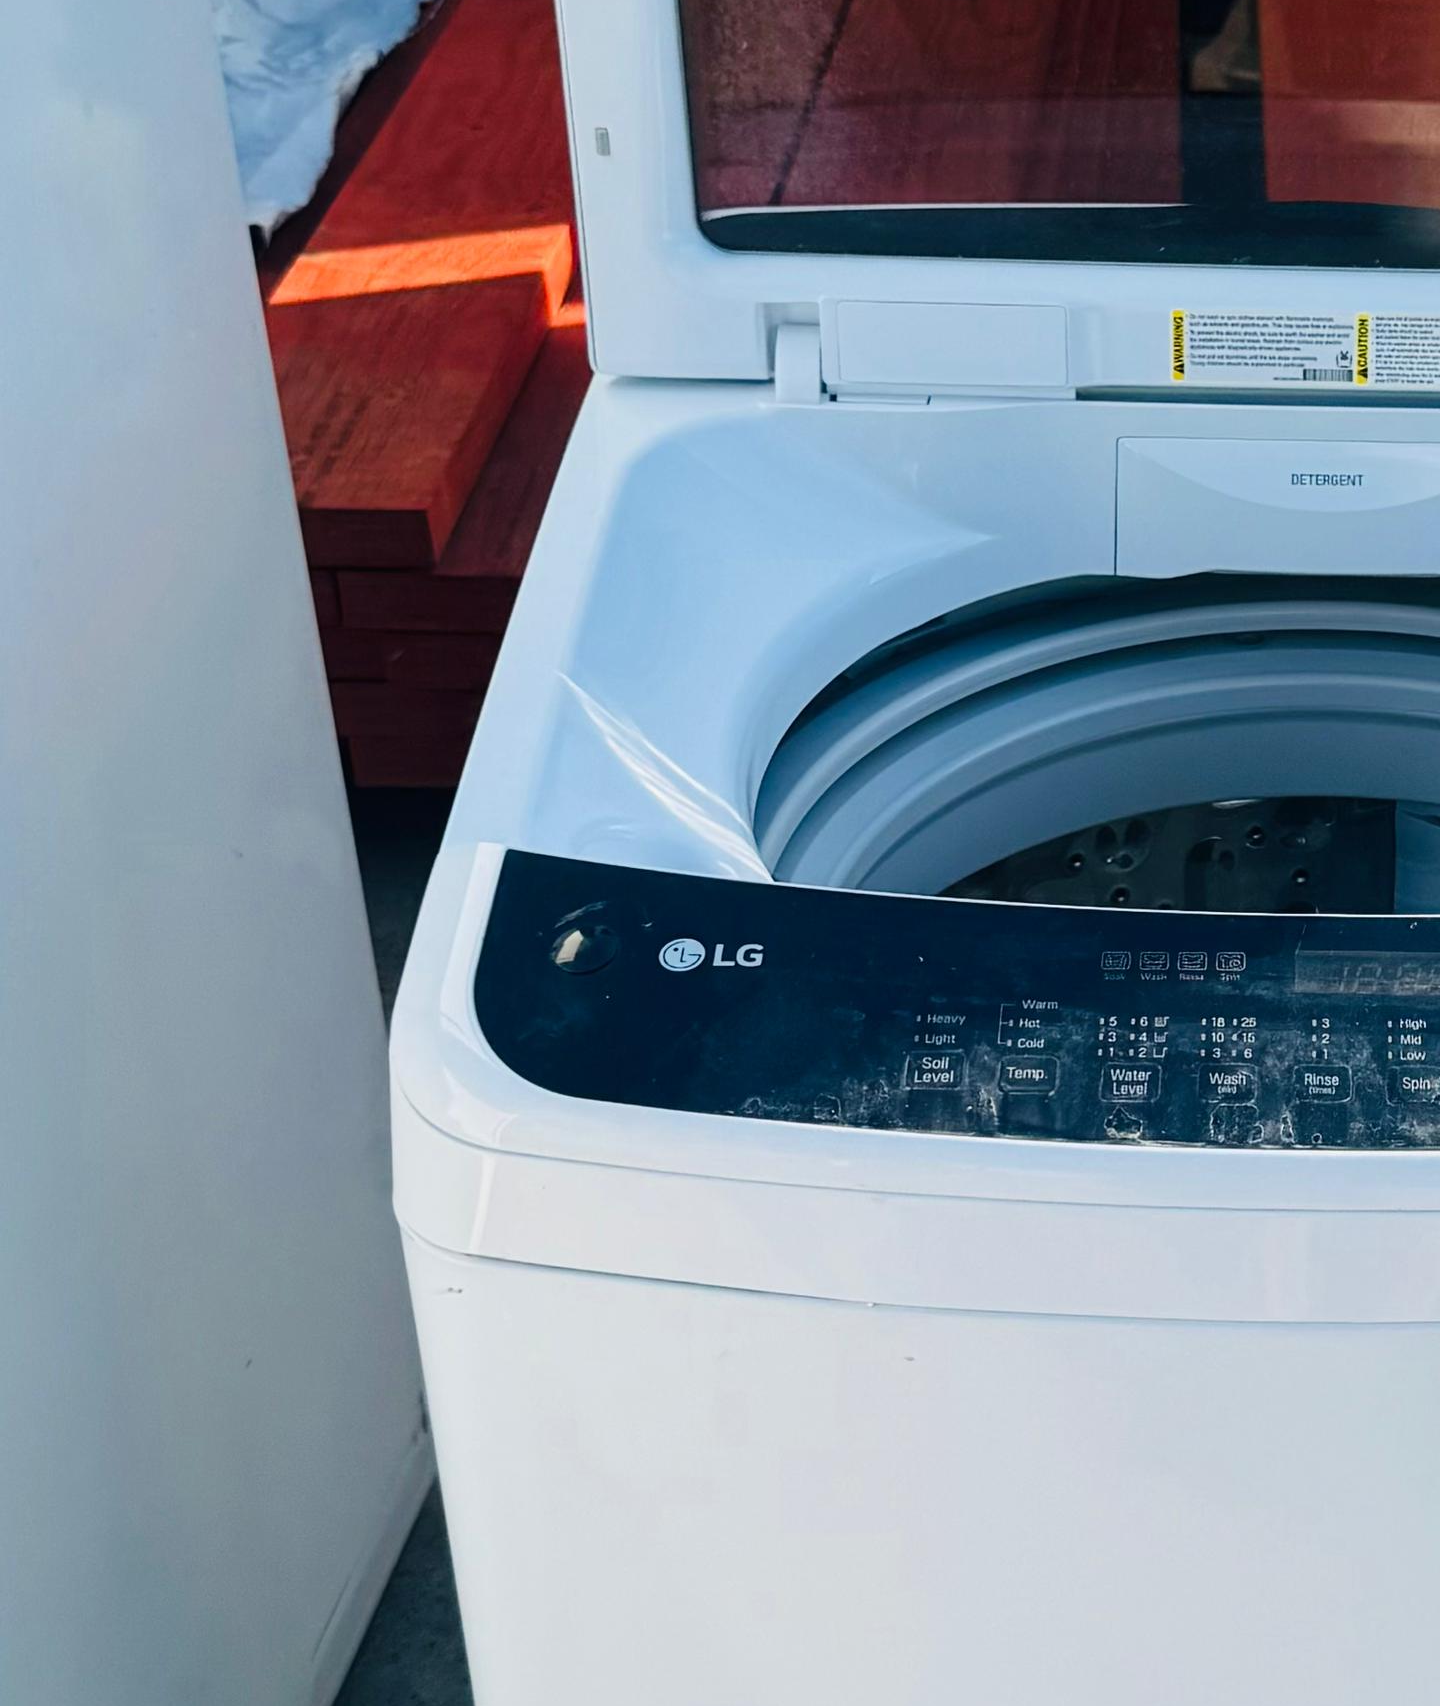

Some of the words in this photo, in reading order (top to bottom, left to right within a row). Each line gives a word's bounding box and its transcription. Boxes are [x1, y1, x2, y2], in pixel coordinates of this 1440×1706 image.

[1173, 317, 1184, 363] WARNING
[1357, 318, 1368, 367] CAUTION
[1291, 473, 1364, 486] DETERGENT
[713, 944, 764, 967] LG
[1022, 999, 1058, 1010] Warm
[927, 1014, 966, 1025] Heavy
[1019, 1018, 1041, 1028] Hot
[1109, 1016, 1117, 1027] 5
[1140, 1016, 1148, 1027] 6
[1211, 1017, 1225, 1027] 18
[1322, 1018, 1330, 1028] 3
[1400, 1019, 1427, 1030] High
[925, 1034, 956, 1045] Light
[1108, 1032, 1116, 1042] 3
[1138, 1032, 1147, 1042] 4
[1211, 1032, 1225, 1042] 10
[1322, 1034, 1330, 1043] 2
[1400, 1035, 1421, 1045] Mid
[1017, 1038, 1045, 1048] Cold
[1138, 1048, 1147, 1058] 2
[1212, 1048, 1221, 1058] 3
[1244, 1048, 1252, 1058] 6
[1400, 1050, 1426, 1060] Low
[922, 1057, 950, 1069] Soil
[914, 1070, 954, 1083] Level
[1006, 1067, 1048, 1081] Temp.
[1110, 1069, 1152, 1081] Water
[1209, 1072, 1246, 1085] Wash
[1304, 1073, 1339, 1086] Rinse
[1113, 1083, 1147, 1094] Level
[1402, 1077, 1431, 1090] Spin
